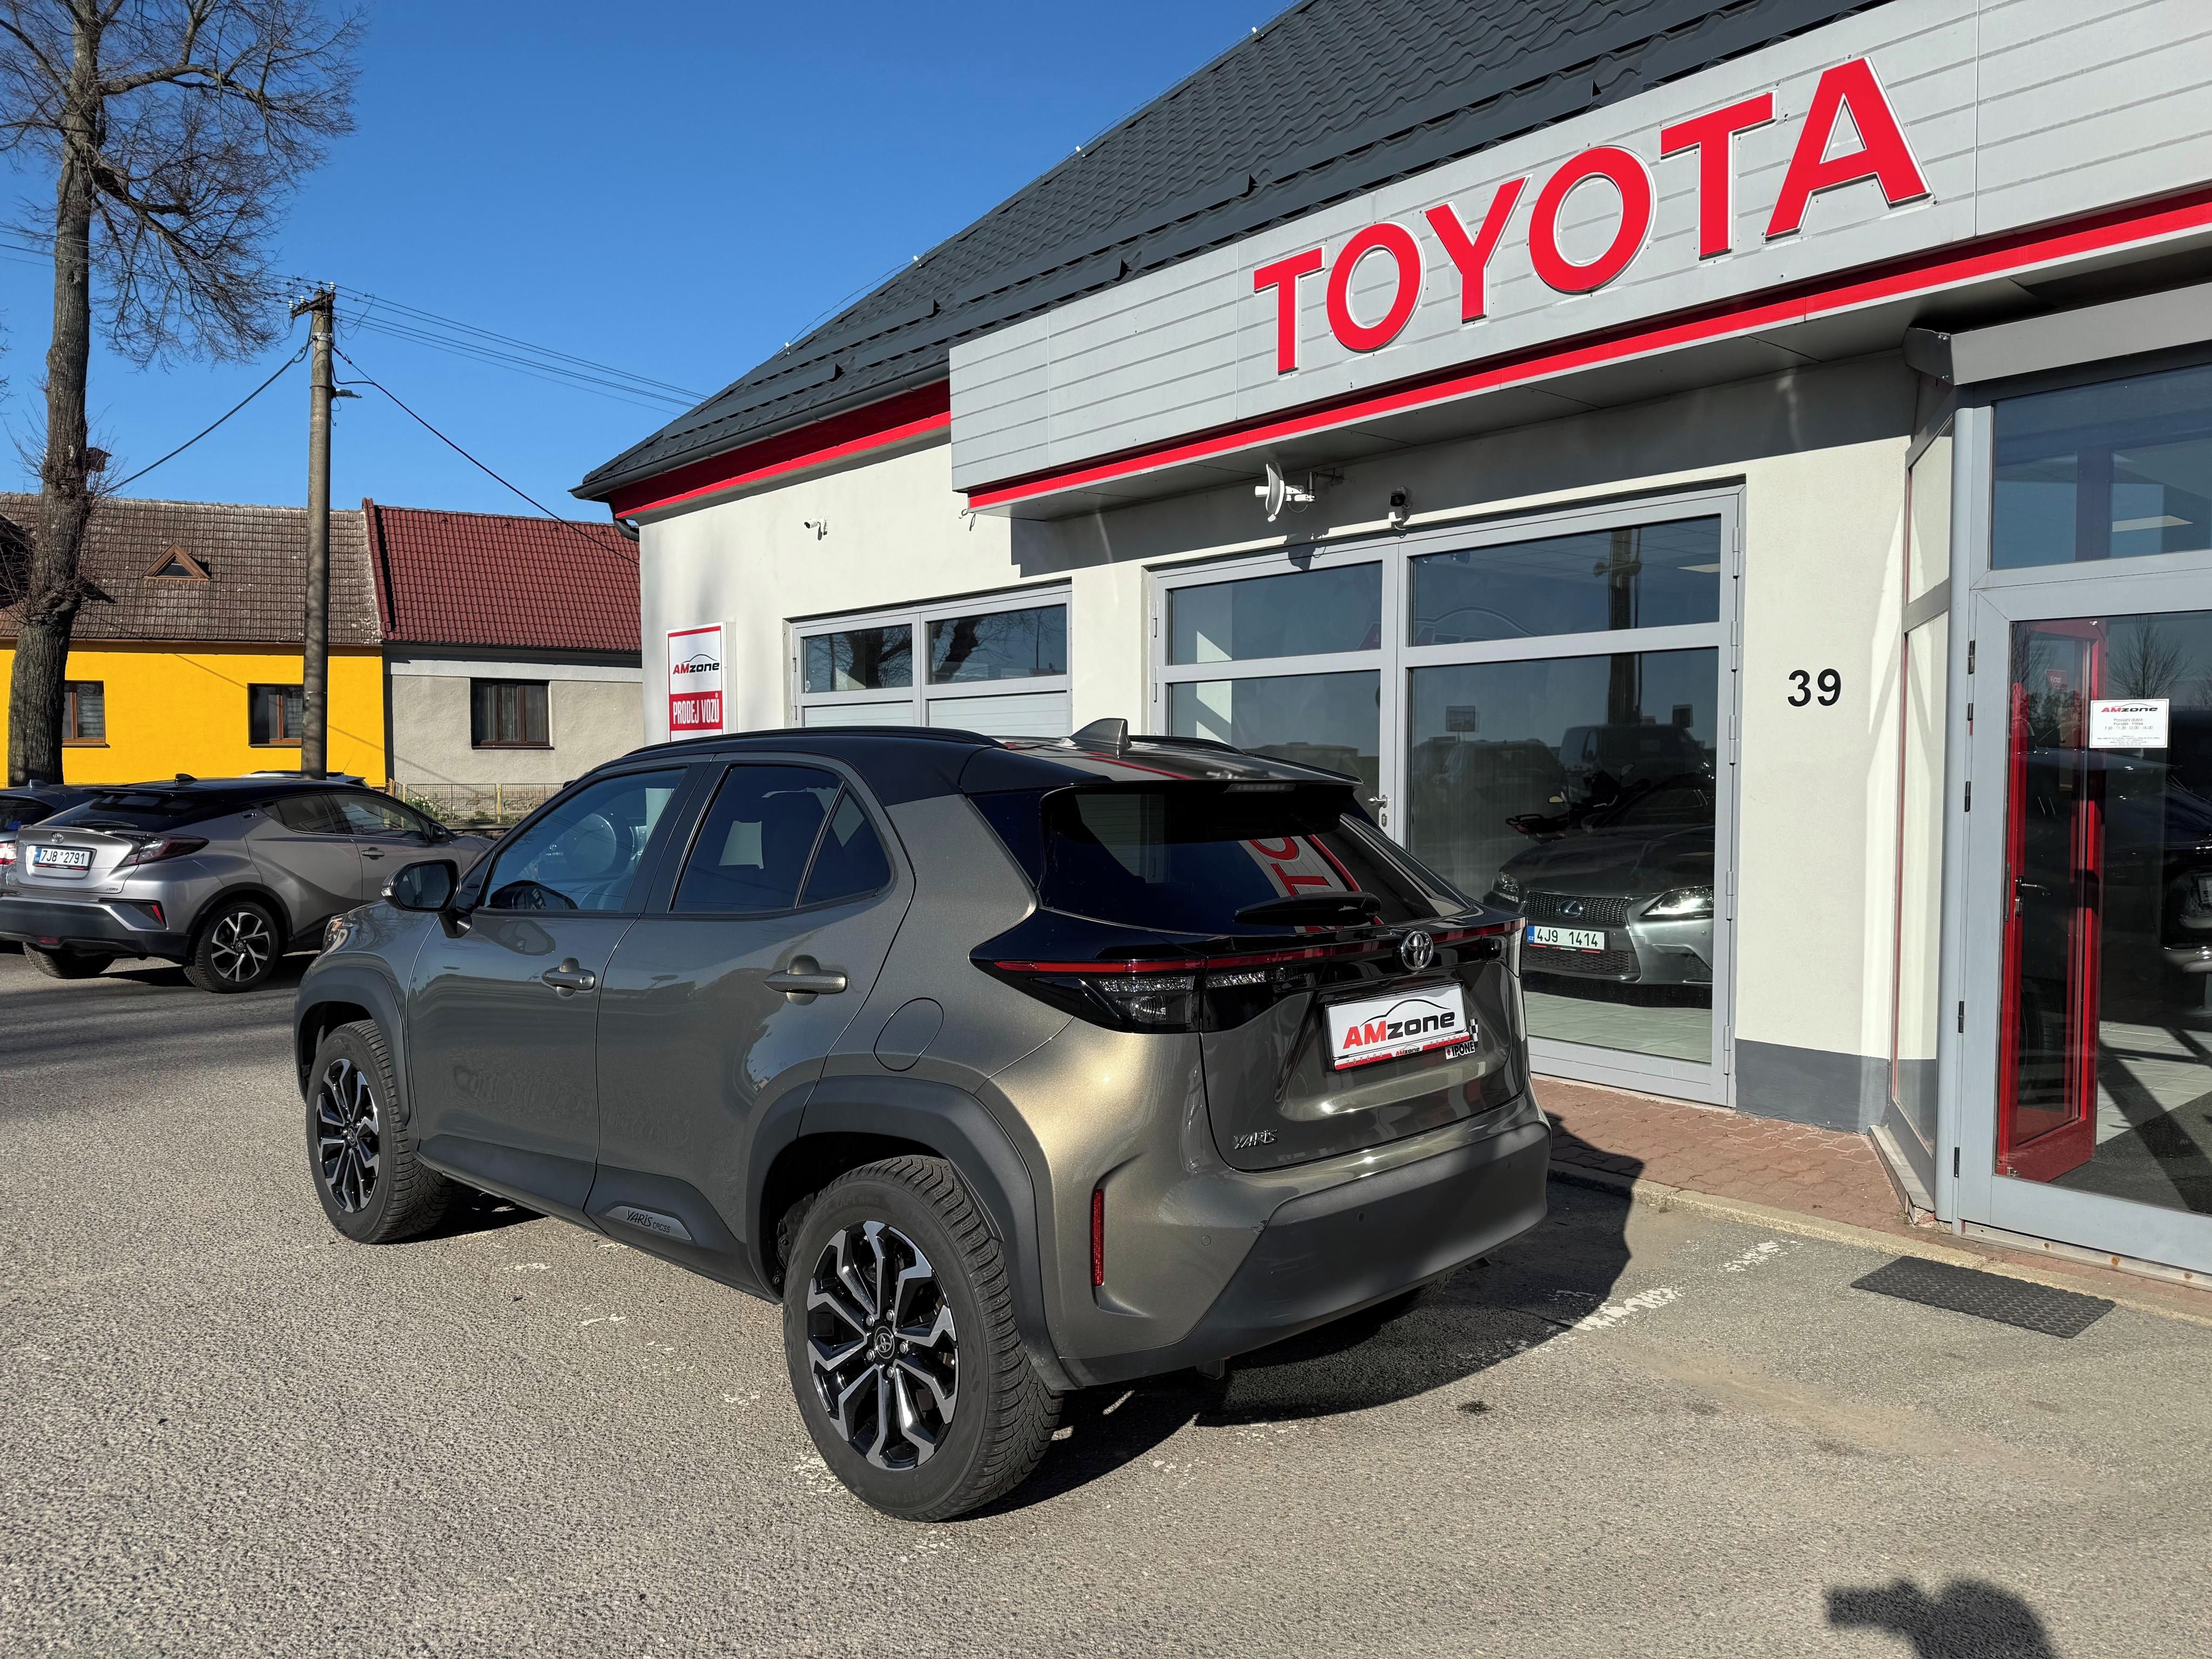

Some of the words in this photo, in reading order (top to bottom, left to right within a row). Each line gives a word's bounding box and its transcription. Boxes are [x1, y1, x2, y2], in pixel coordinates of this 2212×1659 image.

[1253, 56, 1933, 375] TOYOTA
[673, 662, 720, 675] AMzone
[1788, 668, 1842, 707] 39
[673, 699, 699, 725] PRODEJ
[701, 692, 720, 724] VOZŮ
[41, 850, 58, 862] 7J8
[63, 852, 85, 865] 2791
[1537, 928, 1558, 942] 4J9
[1569, 931, 1598, 947] 1414
[1343, 1011, 1455, 1049] AMzone
[1395, 1047, 1420, 1056] AMzone
[1452, 1041, 1474, 1057] IPONE
[1233, 1129, 1278, 1149] YARIS
[626, 1209, 653, 1227] YARIS
[652, 1222, 671, 1233] CROSS
